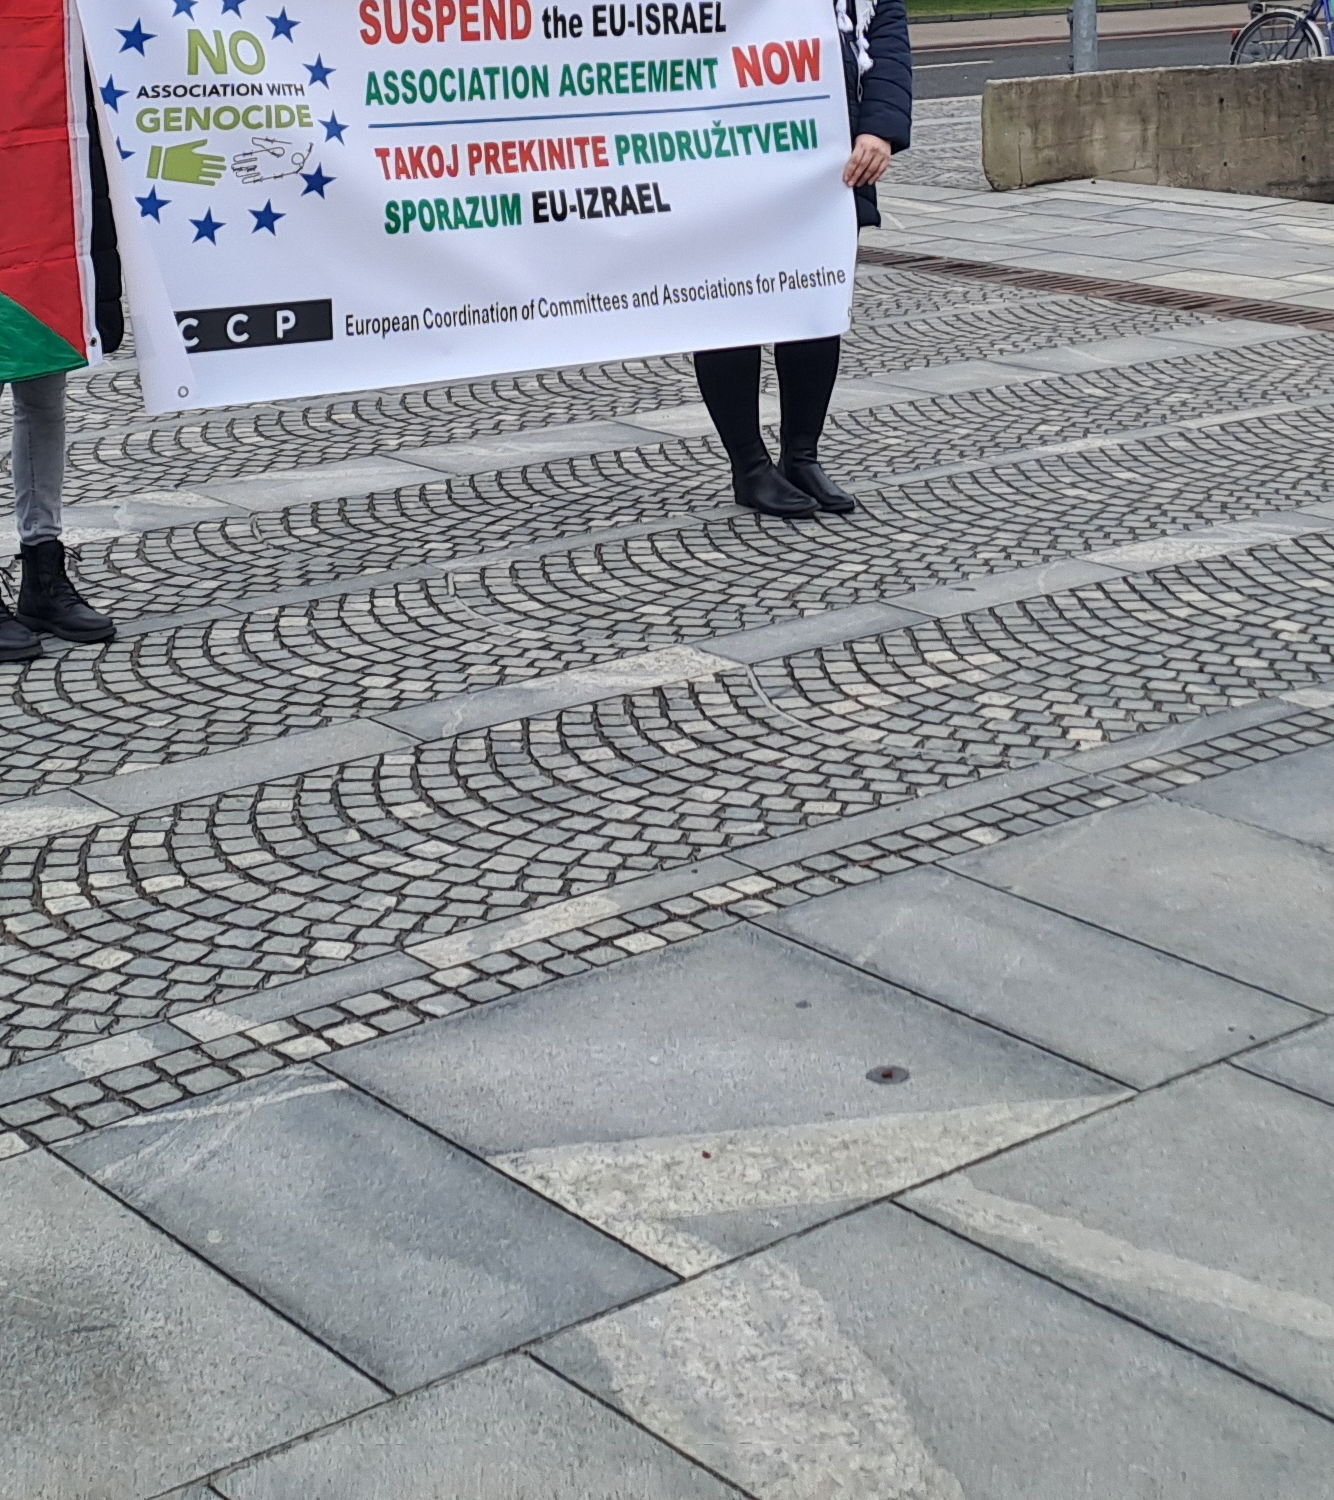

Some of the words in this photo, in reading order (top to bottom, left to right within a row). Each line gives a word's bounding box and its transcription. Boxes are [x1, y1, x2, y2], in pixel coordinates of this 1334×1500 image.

[542, 6, 583, 39] the
[592, 1, 726, 37] EU-ISRAEL
[187, 29, 265, 75] NO
[366, 65, 549, 106] ASSOCIATION
[559, 58, 718, 97] AGREEMENT
[732, 38, 820, 88] NOW
[136, 83, 264, 100] ASSOCIATION
[265, 83, 306, 97] WITH
[136, 105, 313, 133] GENOCIDE
[375, 144, 459, 180] TAKOJ
[467, 136, 609, 176] PREKINITE
[615, 118, 818, 166] PRIDRUŽITVENI
[384, 193, 522, 235] SPORAZUM
[532, 182, 671, 223] EU-IZRAEL
[346, 314, 419, 339] European
[423, 302, 517, 329] Coordination
[522, 299, 534, 320] of
[538, 292, 628, 318] Committees
[632, 285, 659, 308] and
[663, 280, 753, 304] Associations
[756, 274, 775, 294] for
[779, 267, 845, 292] Palestine
